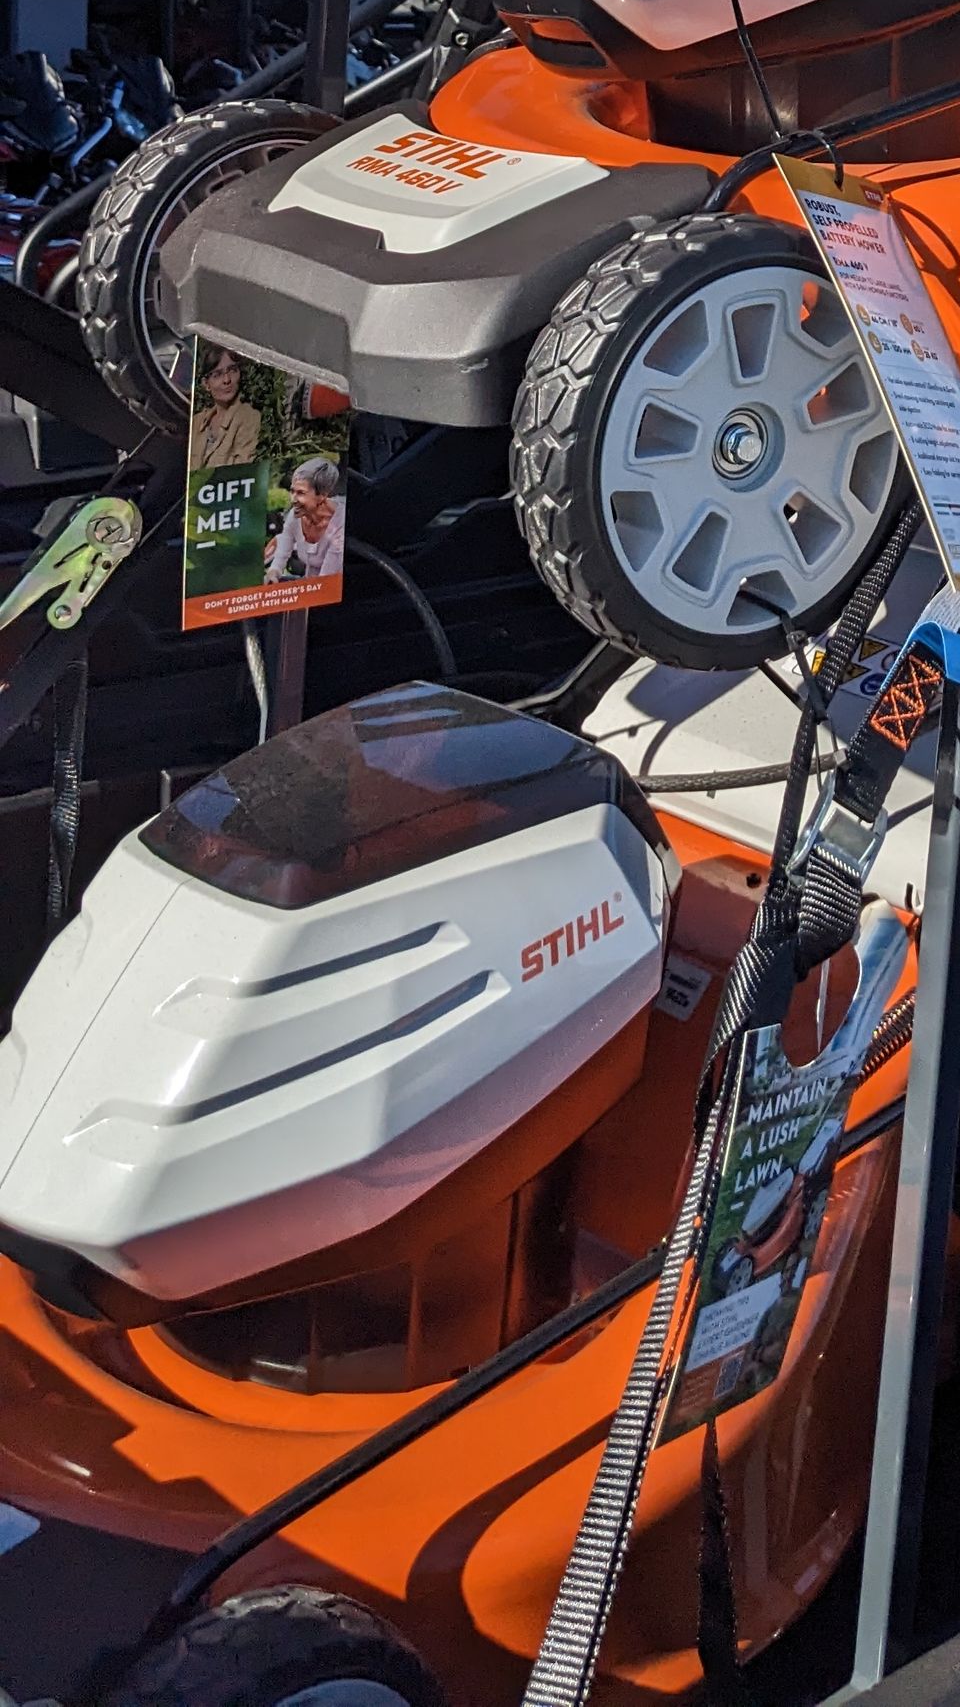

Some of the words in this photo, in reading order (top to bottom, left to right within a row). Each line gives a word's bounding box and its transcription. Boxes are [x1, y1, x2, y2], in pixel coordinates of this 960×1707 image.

[346, 156, 403, 177] RMA
[374, 132, 507, 179] STIHL
[804, 198, 841, 216] ROBUST,
[812, 214, 833, 228] SELF
[834, 219, 880, 239] PROPELLED
[819, 229, 857, 248] BATTERY
[857, 239, 887, 255] MOWER
[198, 478, 255, 504] GIFT
[196, 508, 240, 534] ME!
[204, 598, 229, 610] DON'T
[231, 592, 263, 605] FORGET
[265, 587, 305, 600] MOTHER'S
[306, 583, 322, 592] DAY
[227, 602, 259, 614] SUNDAY
[261, 598, 280, 608] 14TH
[281, 596, 299, 605] MAY
[521, 900, 624, 983] STIHL
[747, 1076, 828, 1126] MAINTAIN
[740, 1137, 753, 1160] A
[757, 1116, 800, 1154] LUSH
[734, 1154, 783, 1193] LAWN
